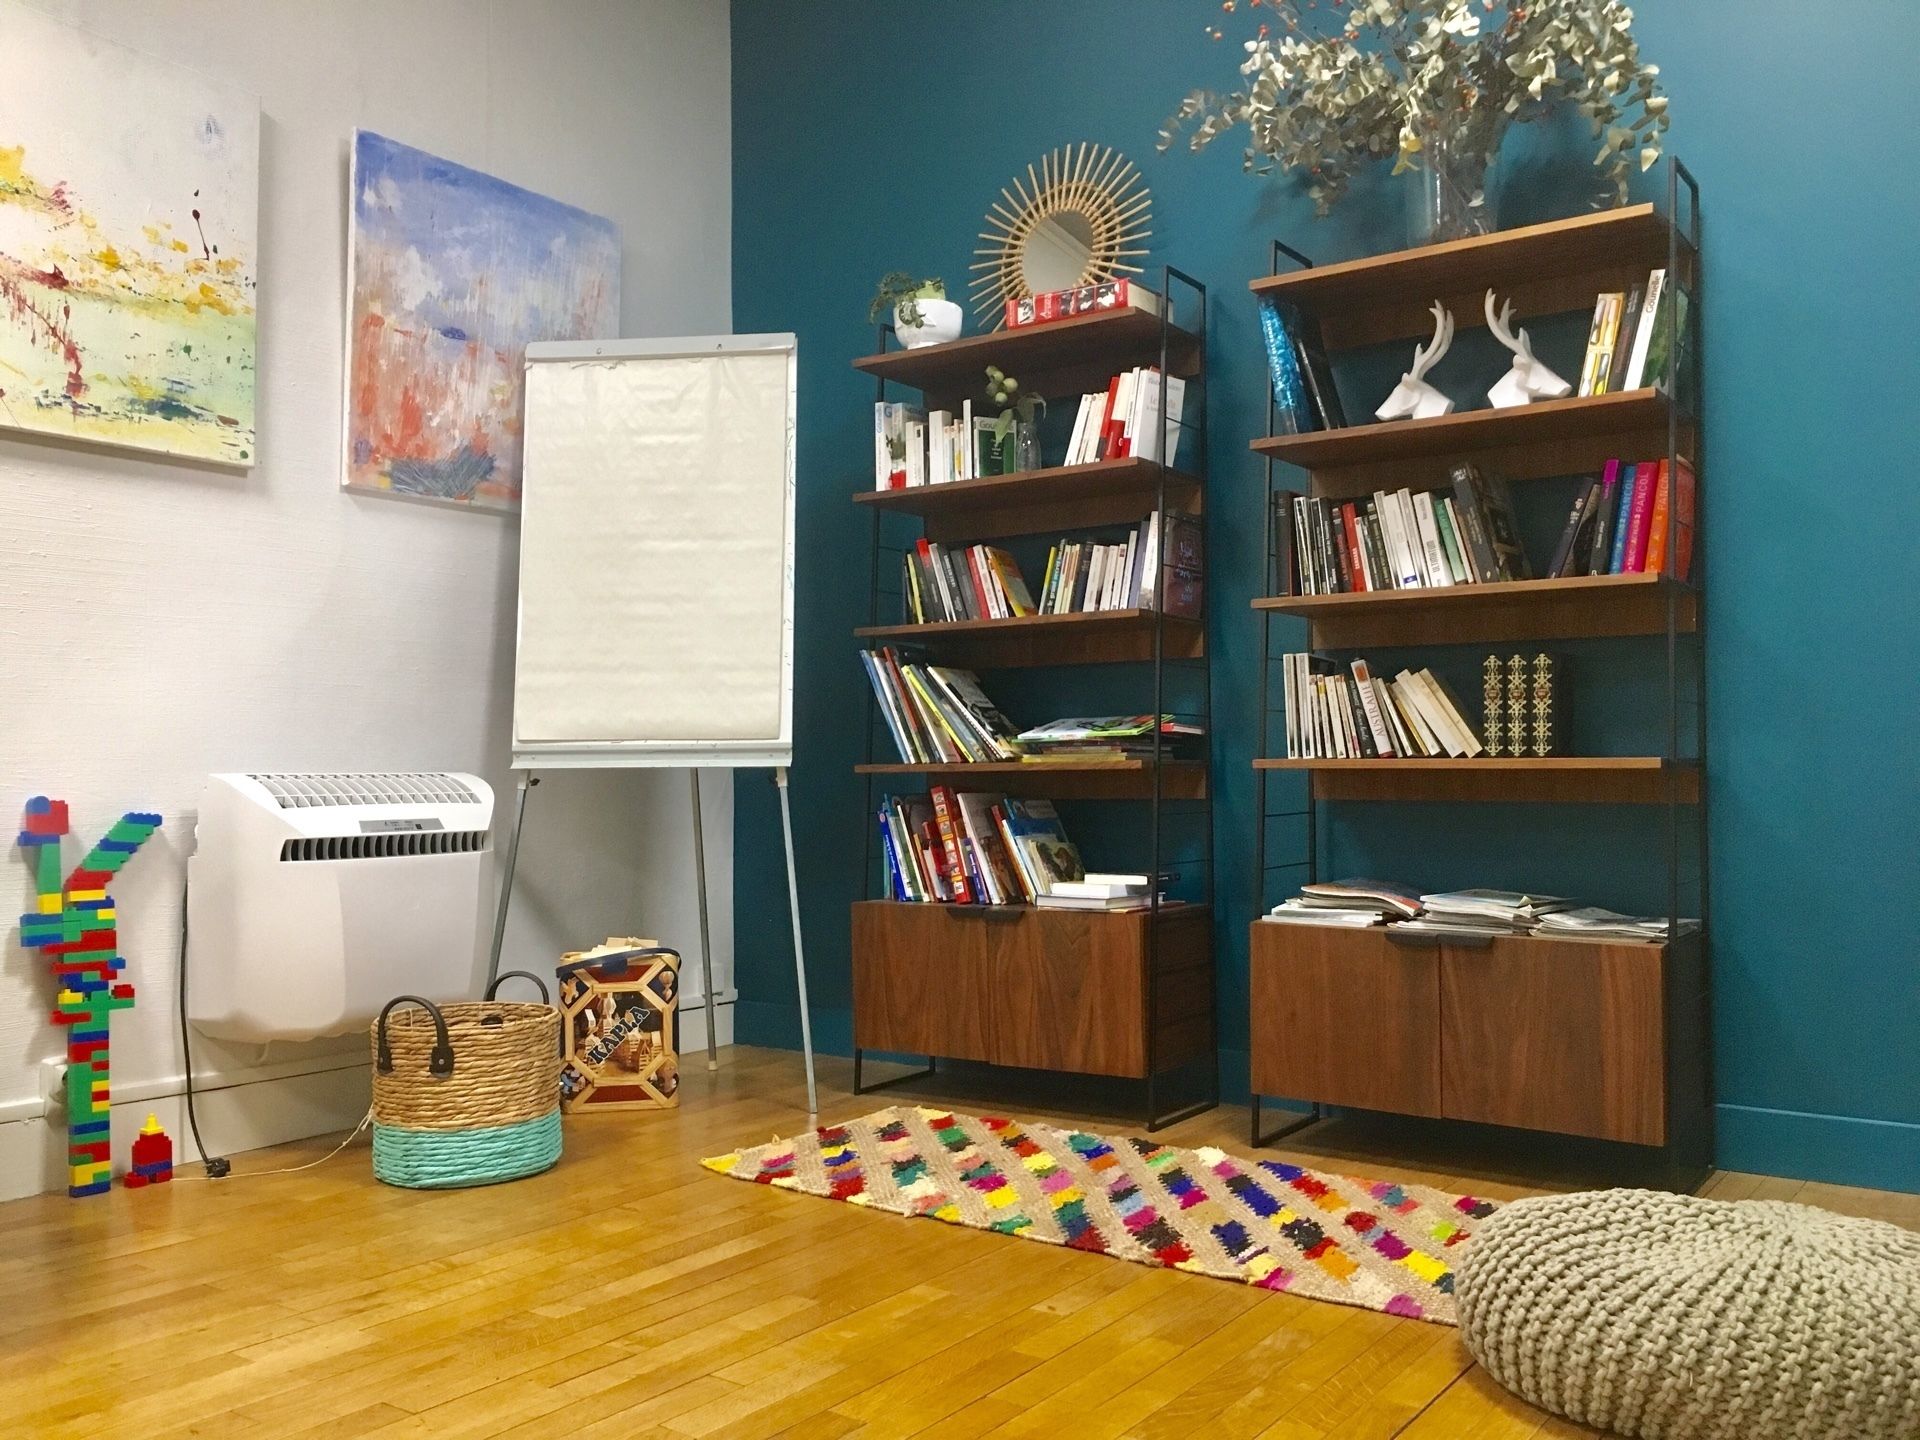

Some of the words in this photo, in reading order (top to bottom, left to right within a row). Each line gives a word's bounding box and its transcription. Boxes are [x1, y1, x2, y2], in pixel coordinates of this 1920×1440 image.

[1646, 275, 1661, 313] Gounelle
[1621, 478, 1634, 517] PANCOL
[1636, 473, 1649, 512] PANCOL
[1427, 540, 1441, 572] ULTIMATUM
[1362, 686, 1384, 736] AUSTRALIE
[588, 1006, 650, 1064] KAPLA
